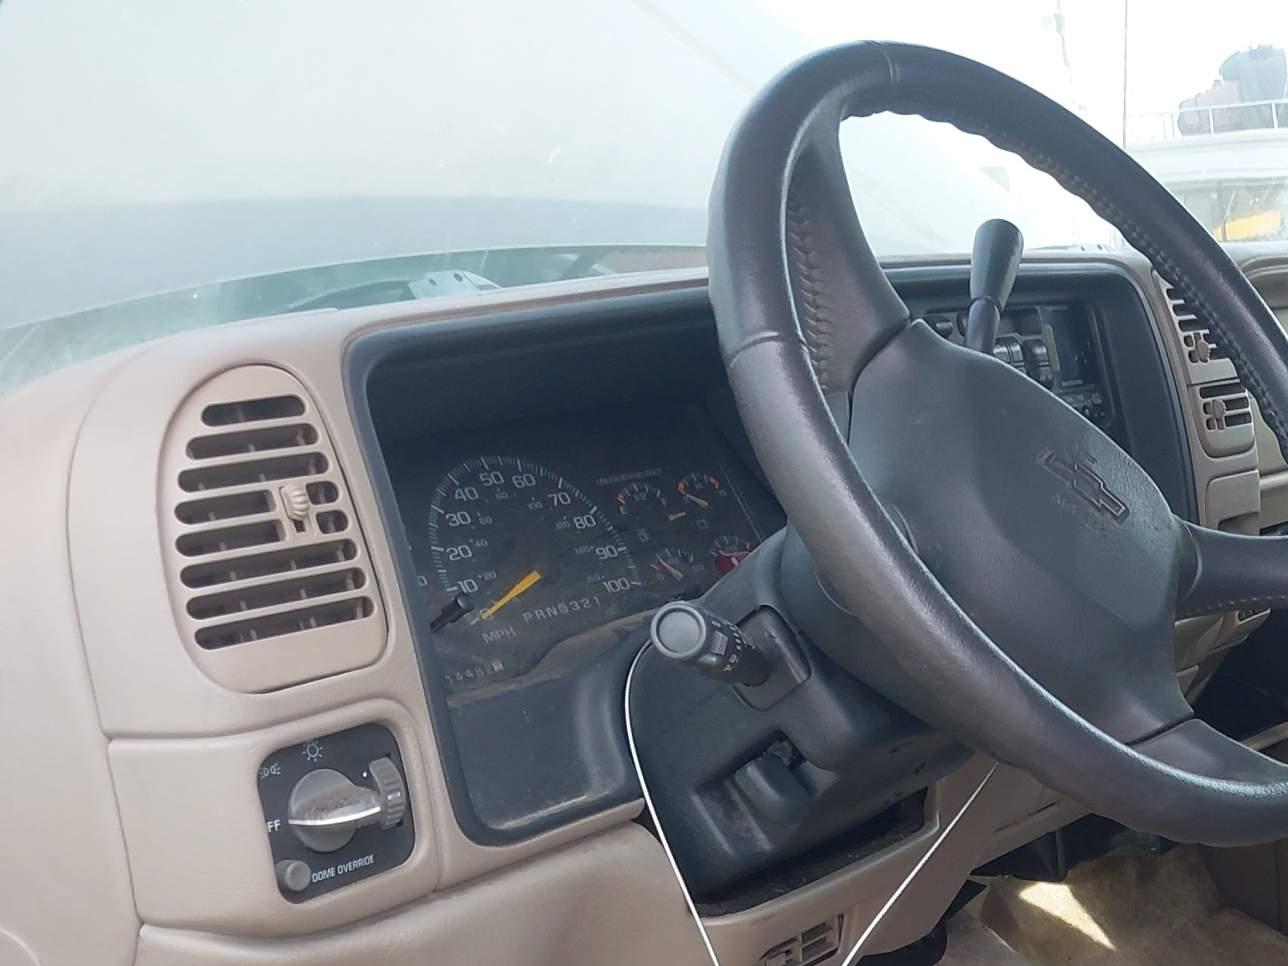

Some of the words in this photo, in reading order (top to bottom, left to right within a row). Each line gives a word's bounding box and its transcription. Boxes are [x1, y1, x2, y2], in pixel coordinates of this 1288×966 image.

[479, 471, 505, 487] 50
[512, 473, 537, 489] 60
[454, 487, 479, 502] 40
[547, 492, 571, 507] 70
[445, 511, 471, 527] 30
[573, 514, 597, 530] 80
[446, 544, 472, 561] 20
[595, 545, 618, 560] 90
[457, 579, 478, 593] 10
[602, 578, 631, 594] 100
[481, 626, 516, 645] MPH
[312, 867, 336, 883] DOME
[337, 854, 375, 875] OVERRIDE
